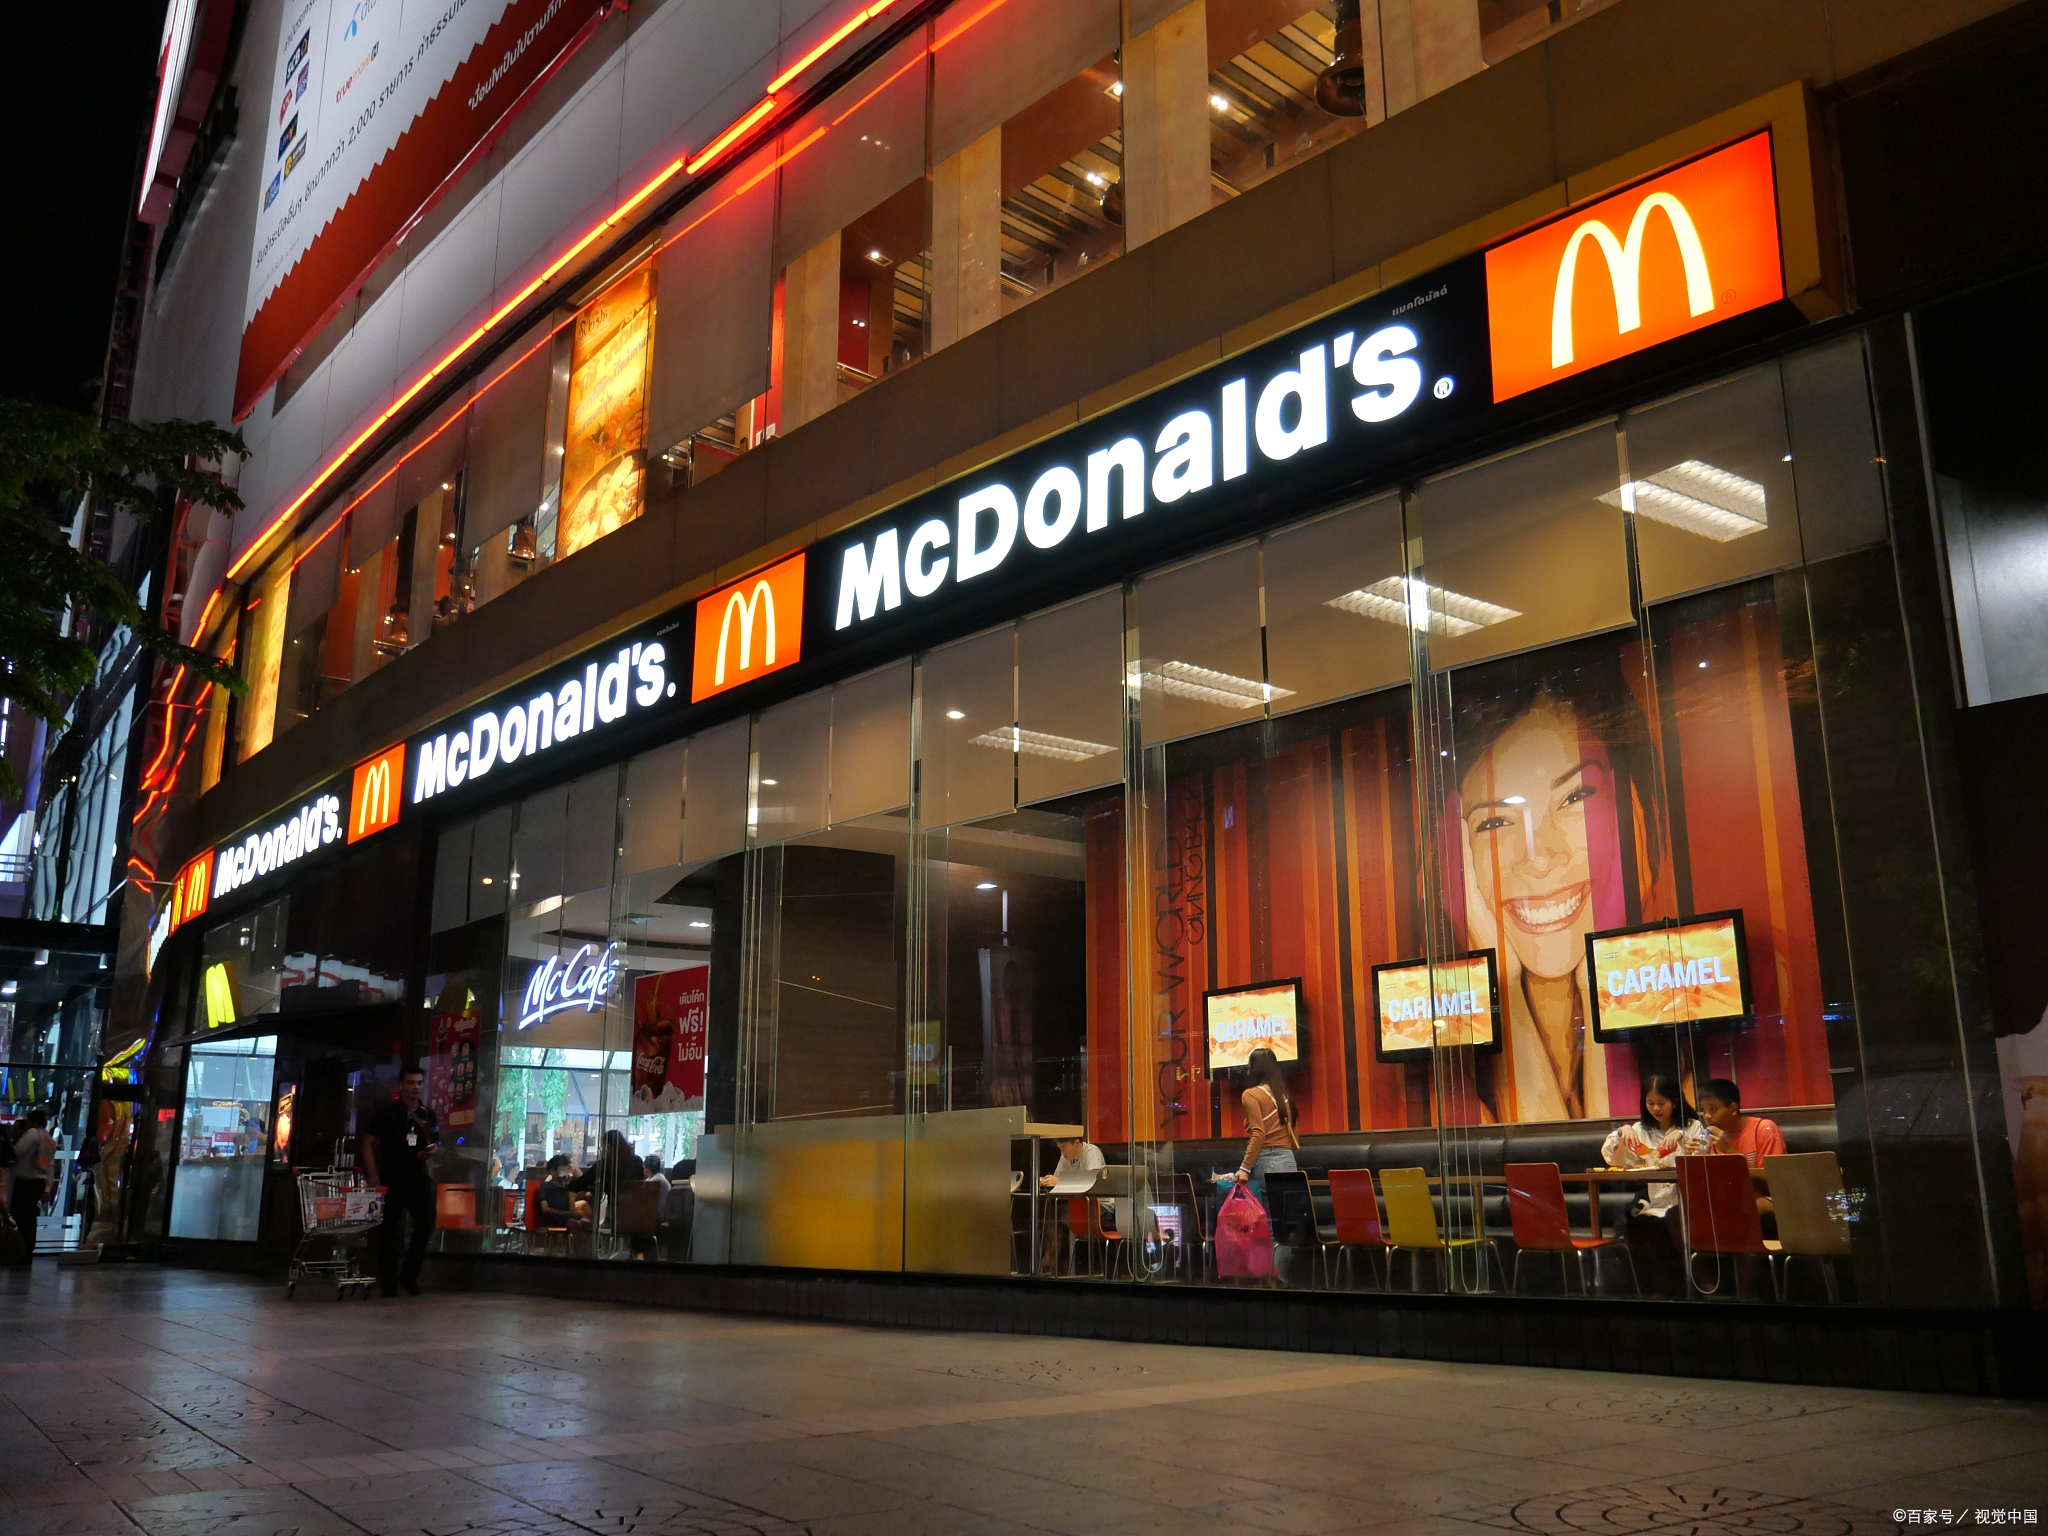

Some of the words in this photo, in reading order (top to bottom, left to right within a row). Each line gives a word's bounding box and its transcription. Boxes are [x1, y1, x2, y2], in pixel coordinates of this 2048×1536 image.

[348, 100, 376, 147] 2,000
[379, 56, 414, 109] รายการ
[835, 323, 1423, 632] McDonald's
[413, 641, 666, 804] McDonald's
[213, 794, 340, 899] McDonald's
[1154, 835, 1185, 997] WORLD
[1184, 853, 1205, 945] GIVING
[679, 1007, 704, 1035] ฟรี!
[1387, 990, 1485, 1023] CARAMEL
[1607, 956, 1733, 997] CARAMEL
[677, 1036, 703, 1062] ไม่อั้น
[1157, 1007, 1189, 1129] YOUR
[1214, 1013, 1293, 1044] CARAMEL
